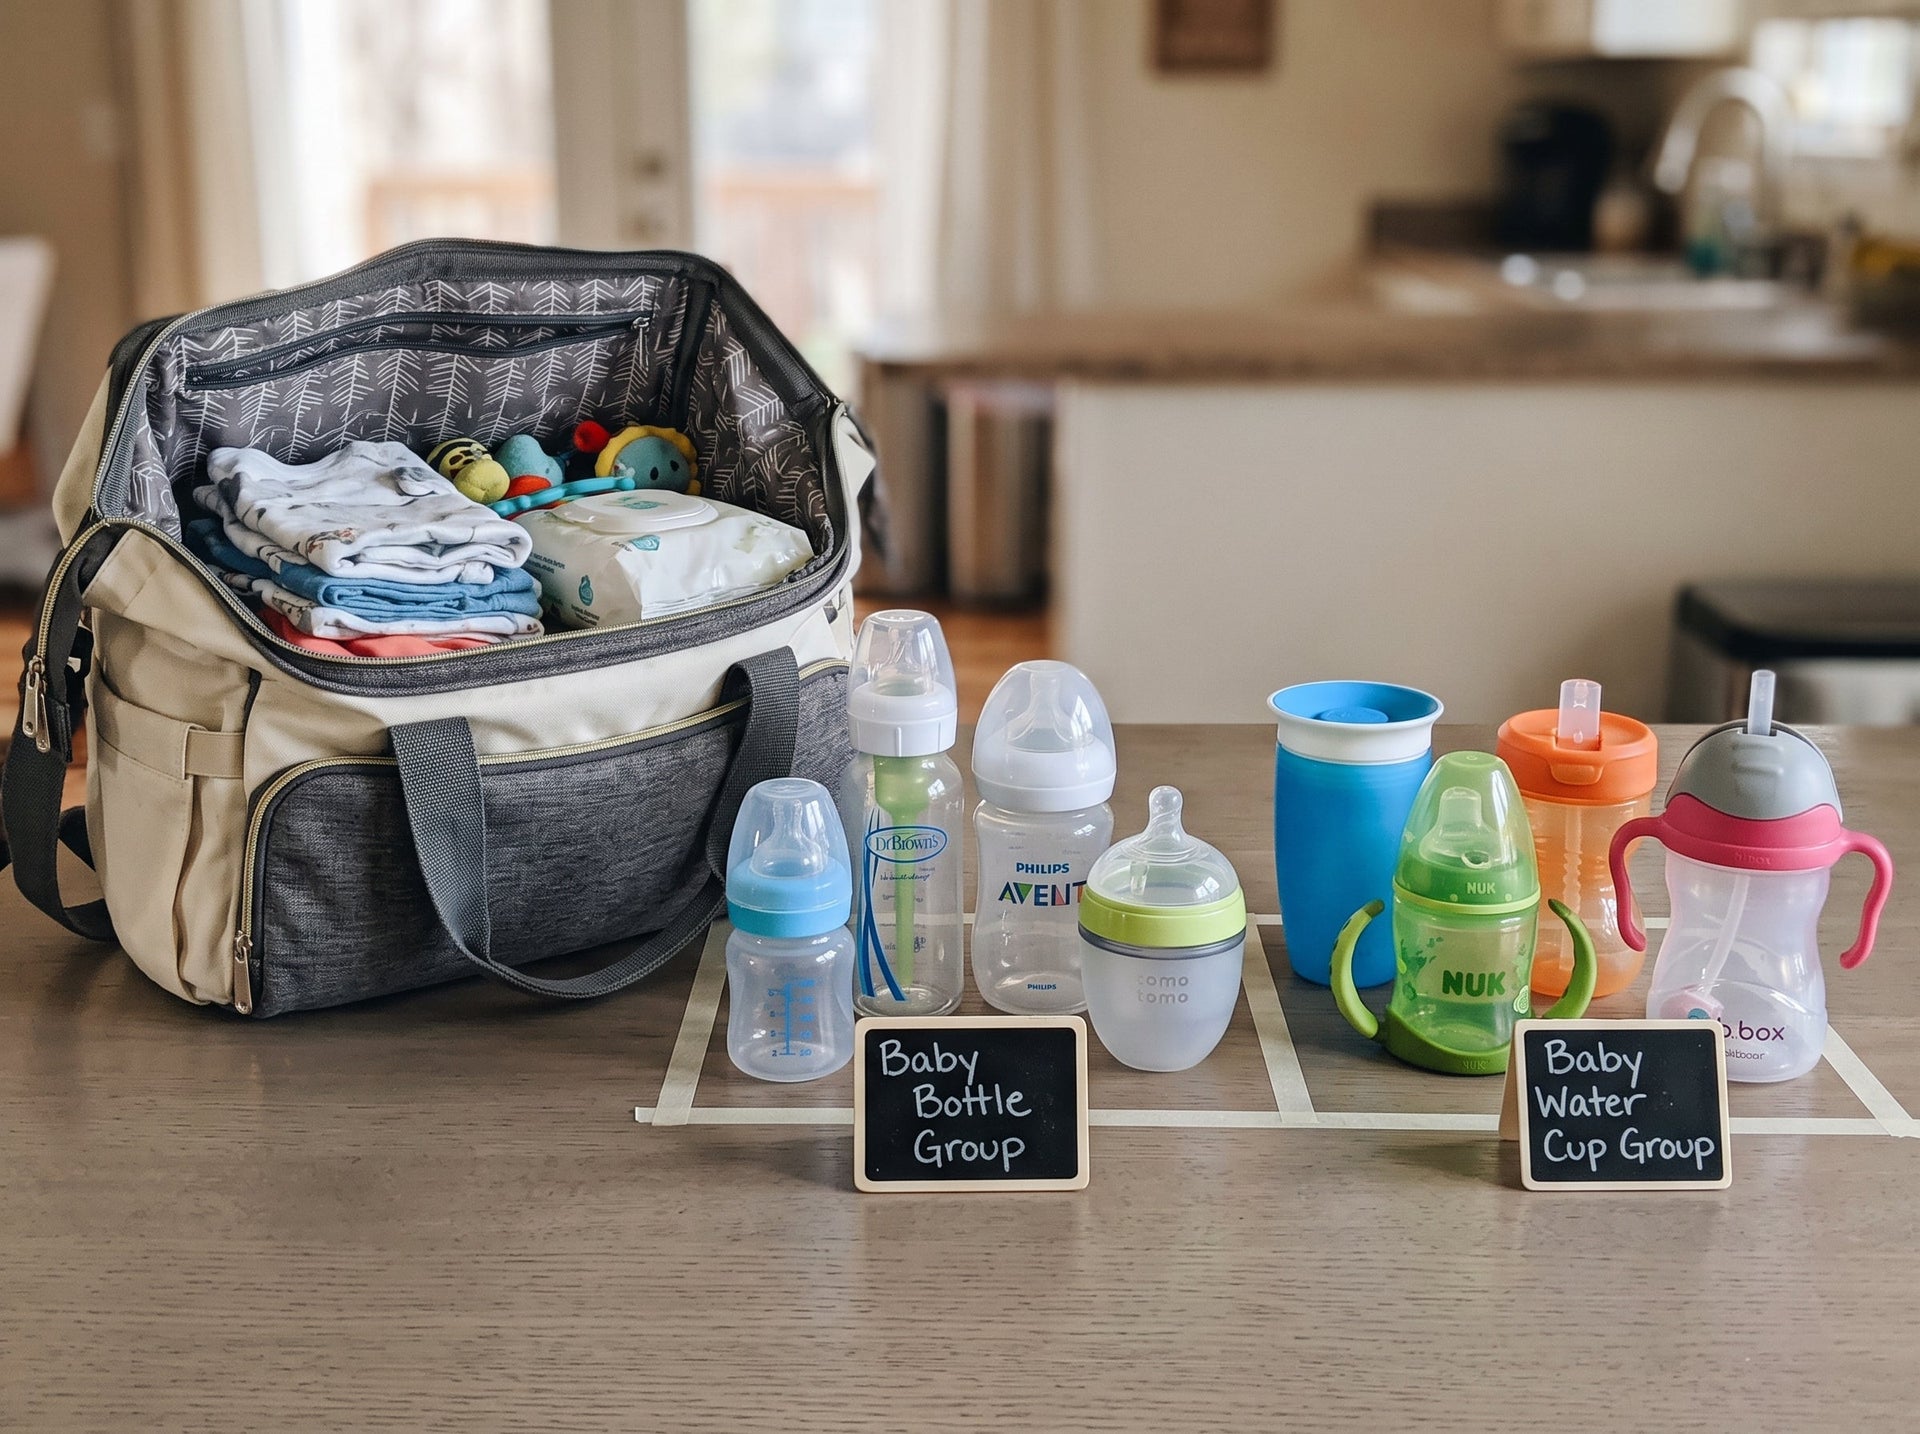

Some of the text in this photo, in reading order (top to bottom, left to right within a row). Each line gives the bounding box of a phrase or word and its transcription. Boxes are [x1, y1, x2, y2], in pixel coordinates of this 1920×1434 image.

[1015, 862, 1070, 874] PHILIPS
[998, 880, 1087, 907] AVENT
[1466, 882, 1496, 895] NUK
[1027, 983, 1057, 991] PHILIPS
[1137, 988, 1189, 1004] tomo
[1442, 970, 1506, 997] NUK
[879, 1038, 979, 1086] Baby
[1544, 1038, 1643, 1089] Baby
[912, 1082, 1032, 1119] Bottle
[1534, 1085, 1648, 1118] Water
[913, 1128, 1026, 1173] Group
[1543, 1126, 1715, 1173] Cup Group
